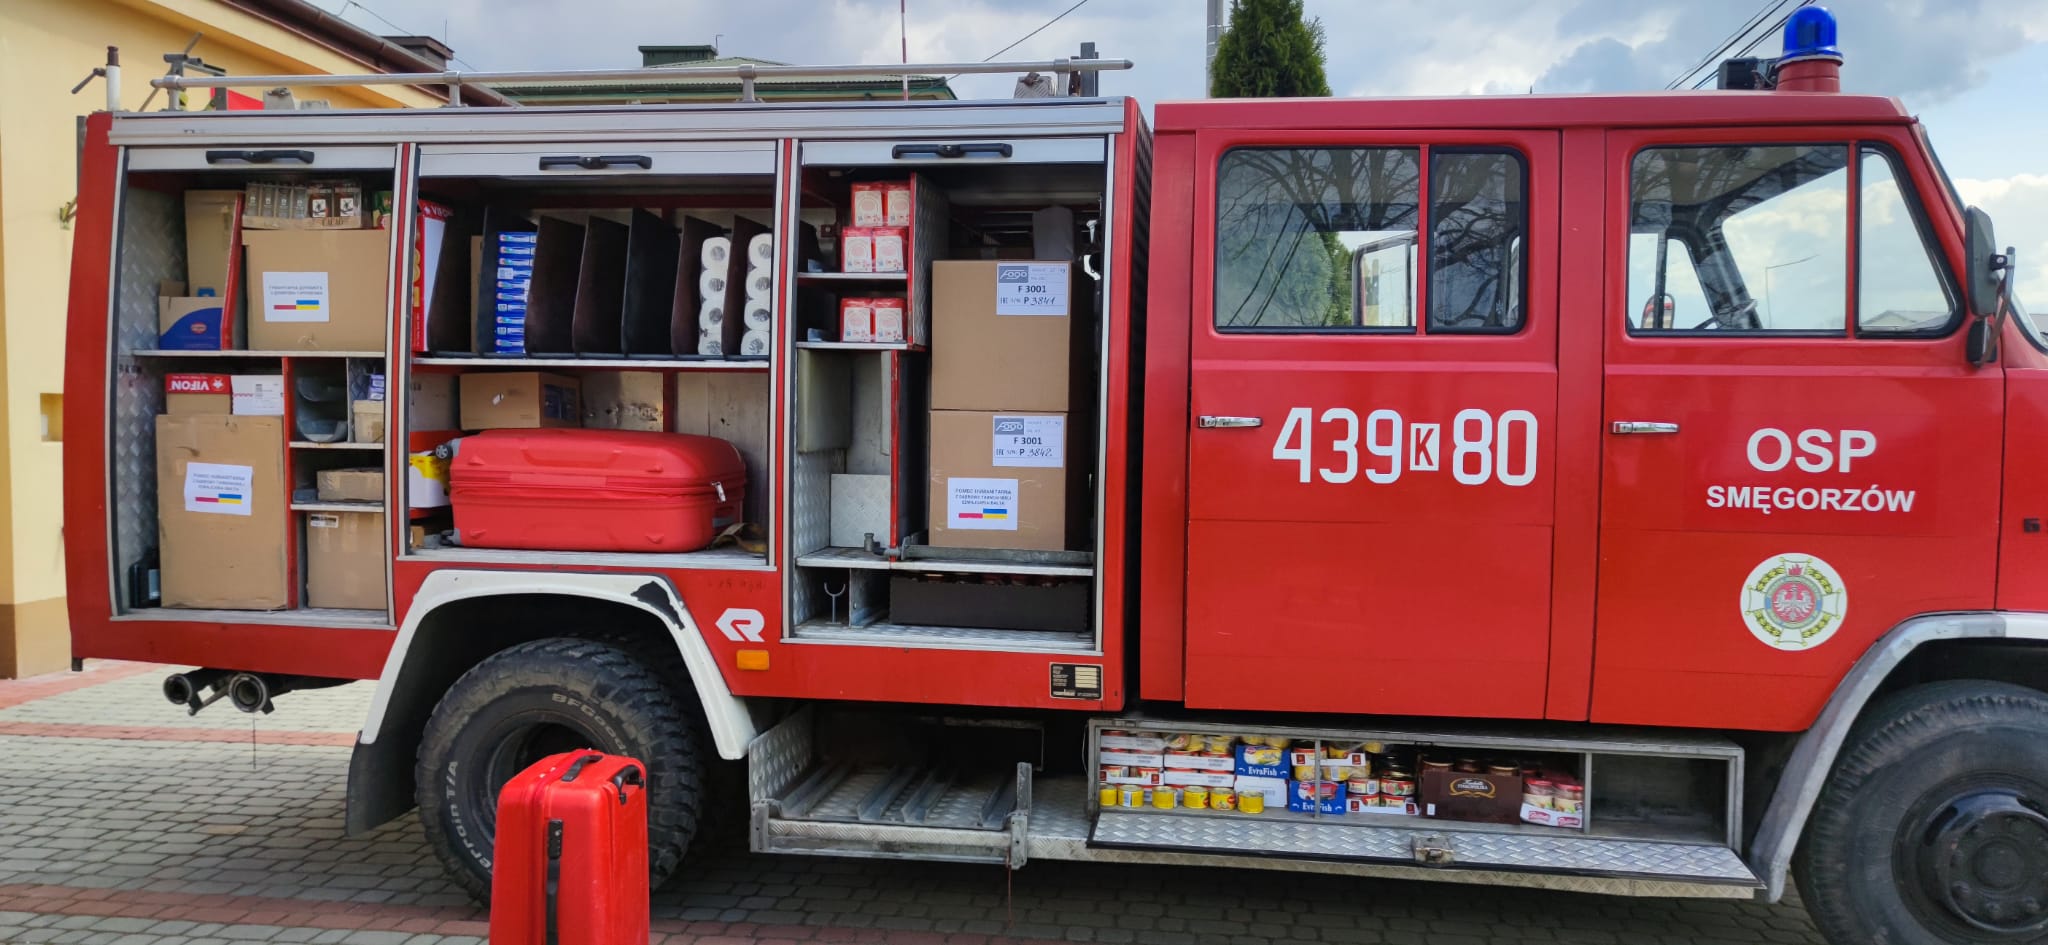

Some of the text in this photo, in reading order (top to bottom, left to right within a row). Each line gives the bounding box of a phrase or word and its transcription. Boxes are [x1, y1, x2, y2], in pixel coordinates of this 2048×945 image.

[1018, 285, 1046, 293] F 3001
[1023, 296, 1029, 304] P
[171, 380, 210, 390] VIFON
[1013, 437, 1042, 445] F 3001
[1019, 448, 1025, 456] P
[1746, 428, 1877, 473] OSP
[1706, 484, 1916, 515] SMĘGORZÓW
[552, 693, 629, 756] BFGood
[1248, 766, 1278, 777] EvraFish
[446, 761, 493, 875] errain T/A
